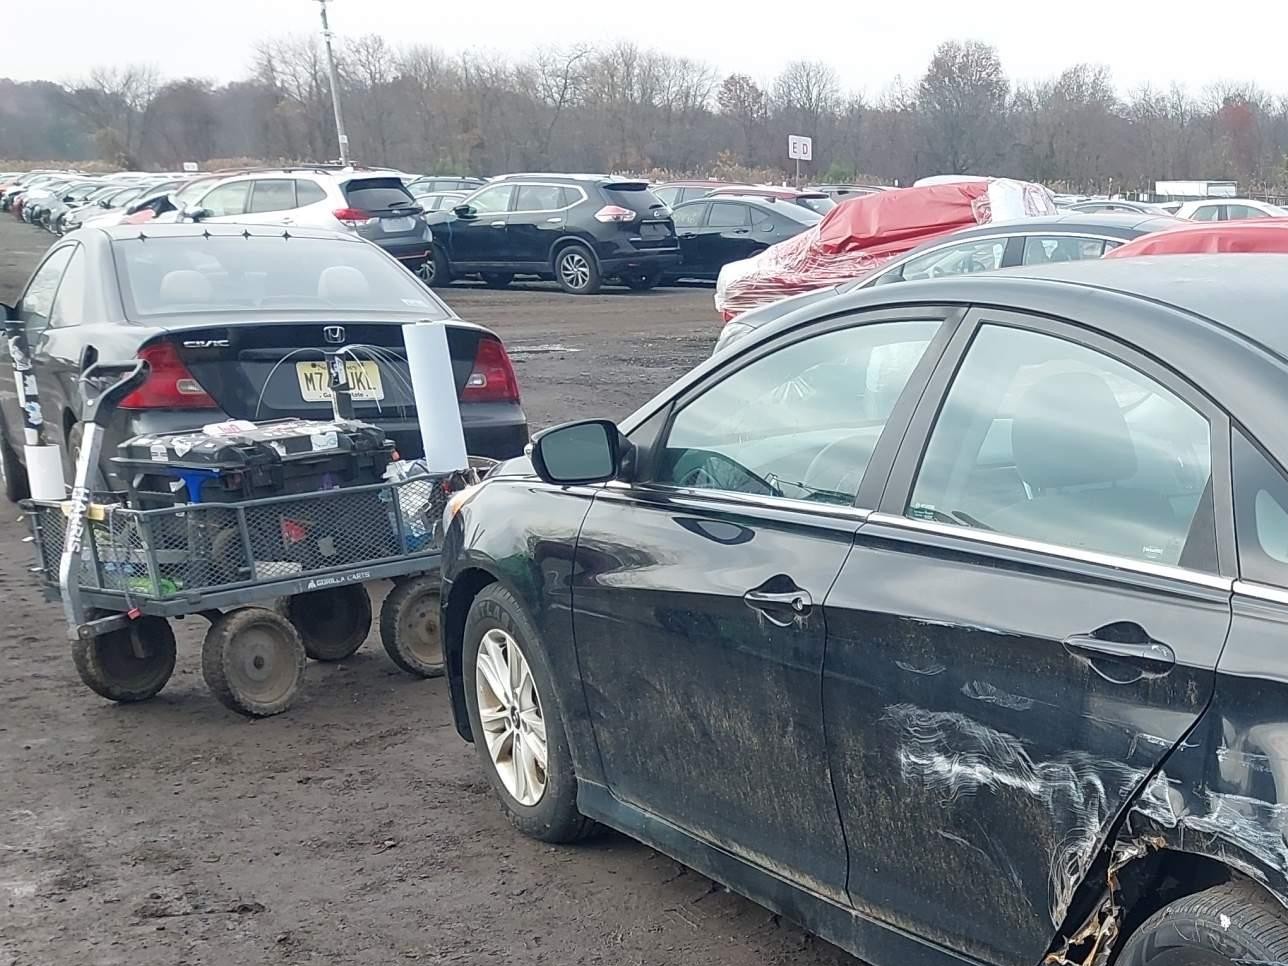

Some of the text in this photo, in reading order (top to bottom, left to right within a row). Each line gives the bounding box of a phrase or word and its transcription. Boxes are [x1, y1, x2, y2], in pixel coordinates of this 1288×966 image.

[183, 340, 230, 348] CIVIC
[316, 571, 371, 587] GORILLA CARTS
